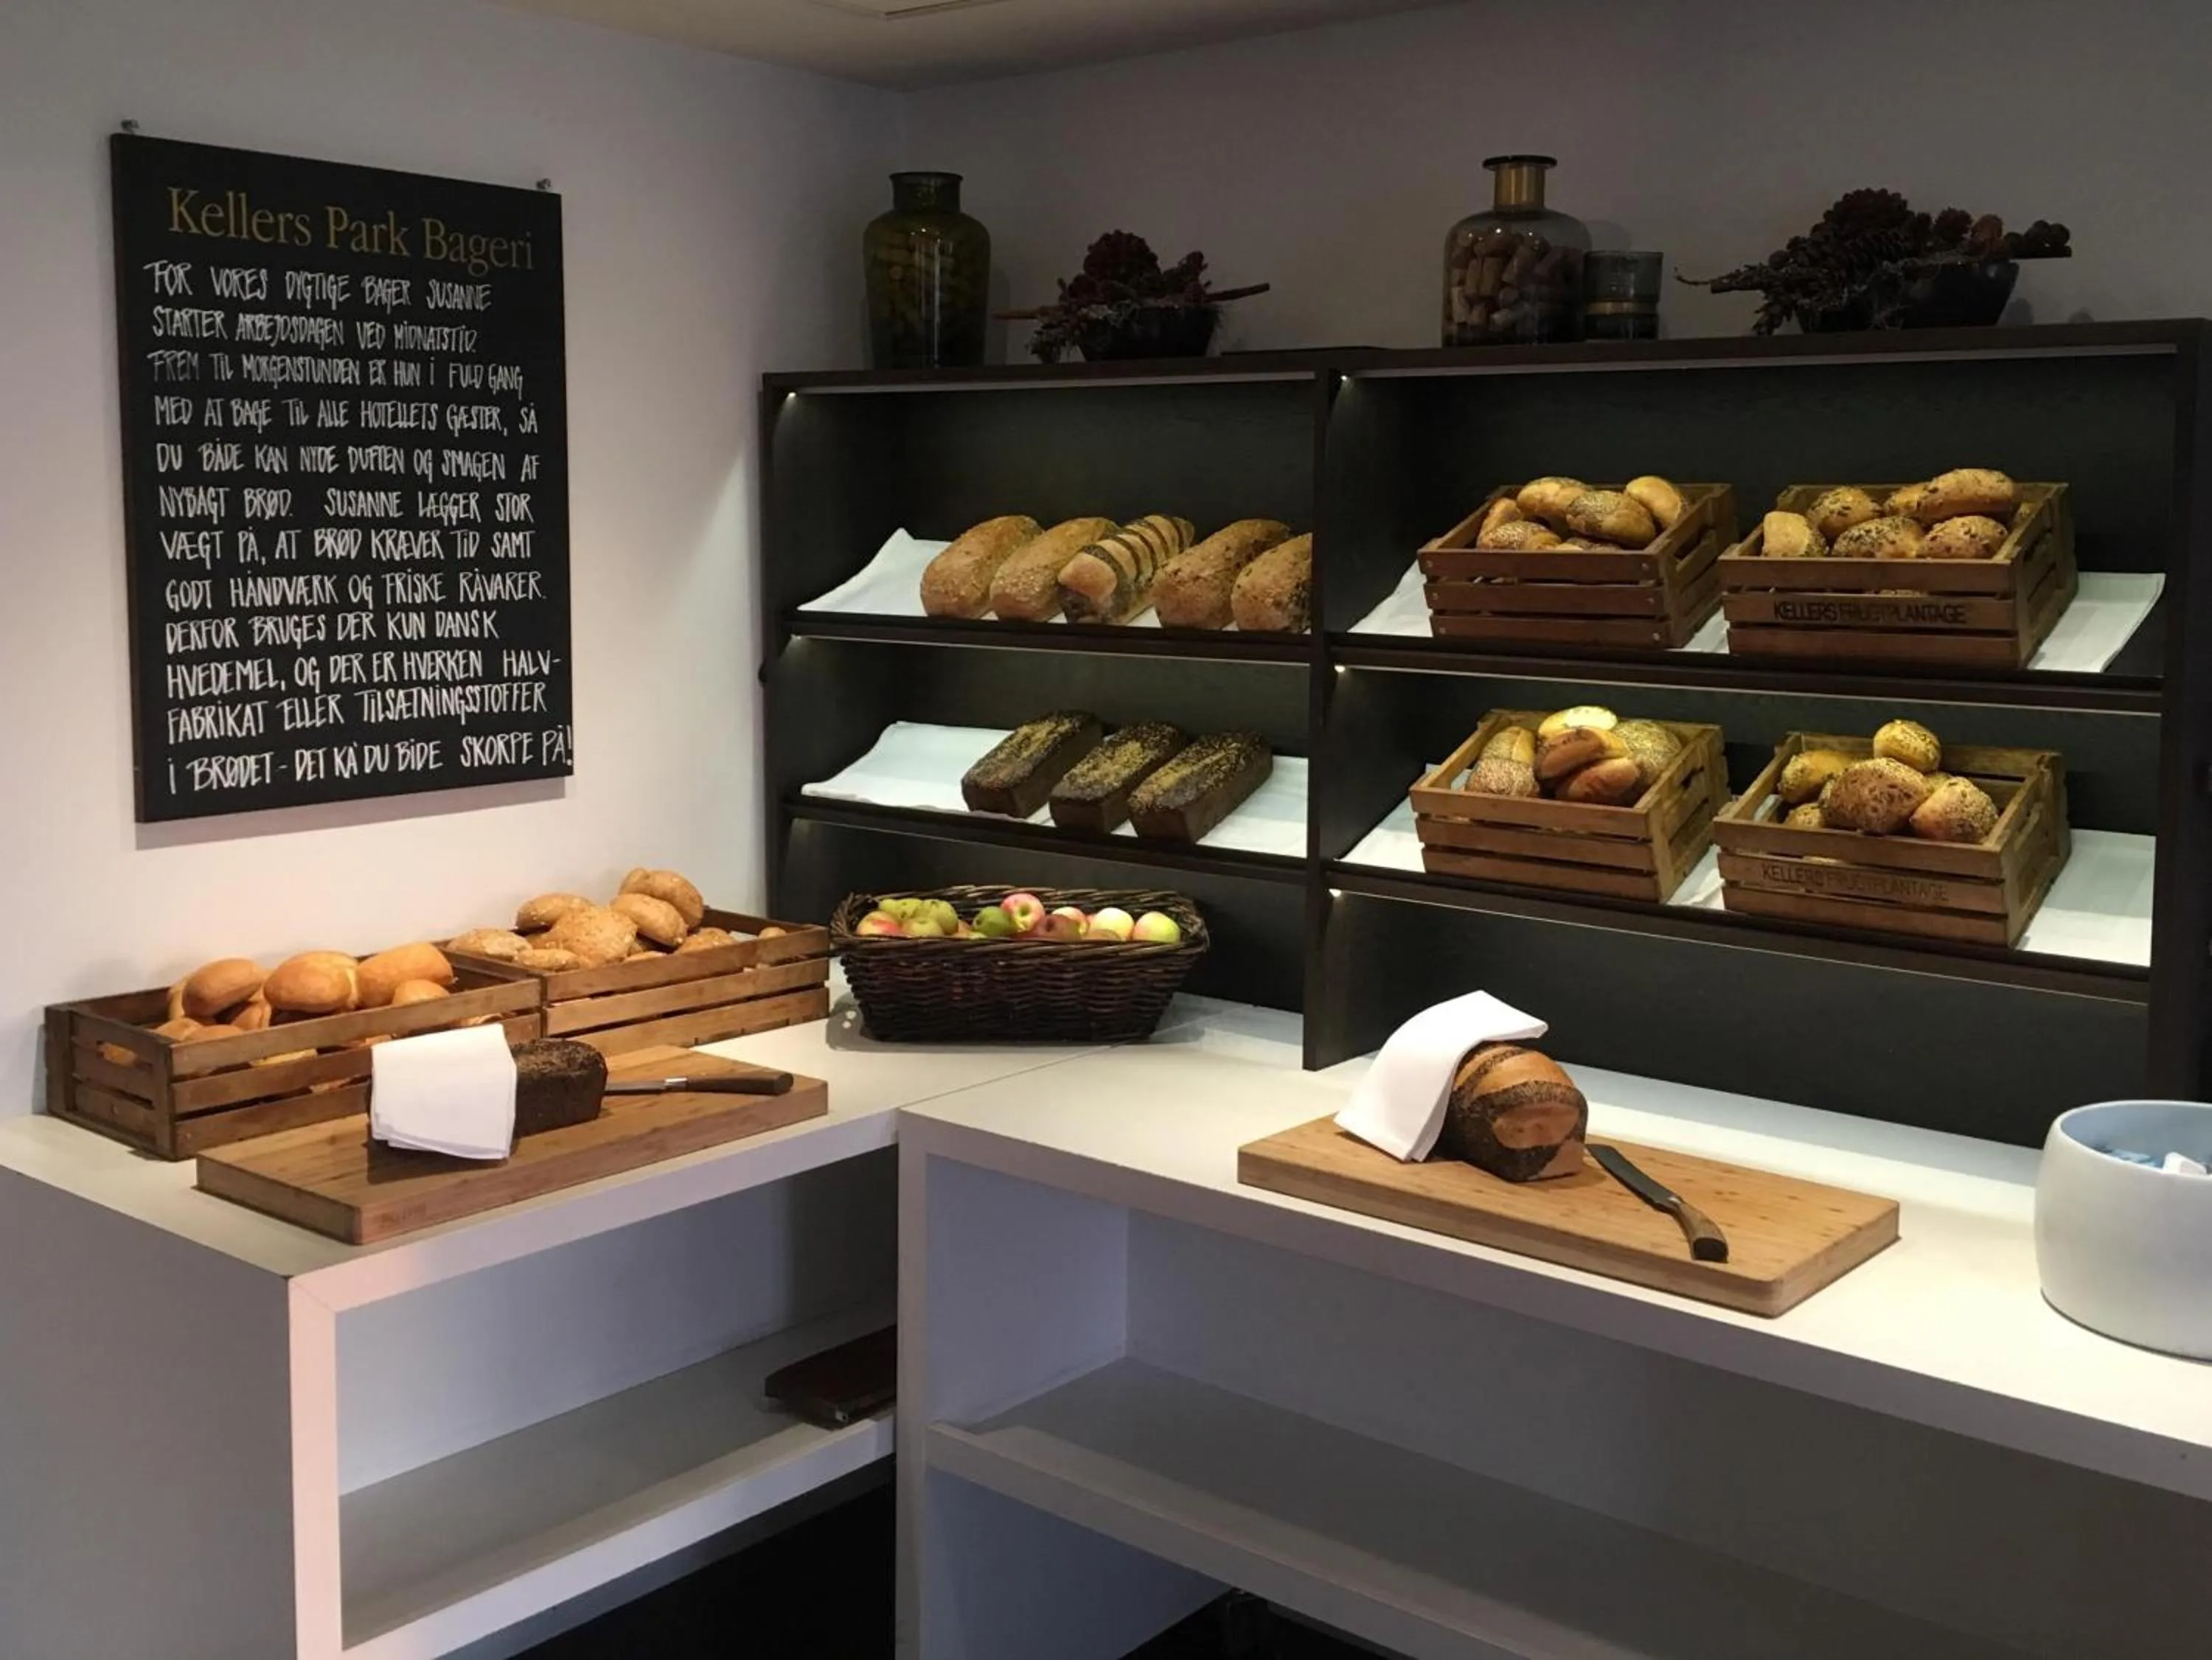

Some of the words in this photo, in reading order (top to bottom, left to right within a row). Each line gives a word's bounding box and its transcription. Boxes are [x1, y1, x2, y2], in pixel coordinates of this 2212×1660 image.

[167, 186, 311, 246] Kellers
[325, 206, 411, 257] Park
[422, 217, 535, 277] Bageri
[144, 259, 192, 297] FOR
[210, 265, 268, 301] VORES
[285, 271, 350, 310] DYGTIGE
[361, 275, 411, 314] BAGER
[425, 279, 492, 311] SUSANNE
[151, 307, 229, 340] STARTER
[236, 313, 344, 352] ARBEJDSDAGEN
[355, 321, 385, 349] VED
[146, 349, 200, 383] FREM
[242, 354, 360, 389] MORGENSTUNDEN
[369, 360, 386, 386] ER
[394, 362, 421, 388] HUN
[449, 363, 483, 390] FULD
[487, 364, 523, 400] GANG
[154, 395, 192, 426] MED
[204, 397, 226, 427] AT
[230, 398, 272, 435] BAGE
[317, 400, 349, 428] ALLE
[361, 401, 437, 430] HOTELLETS
[446, 404, 509, 436] GÆSTER,
[519, 403, 538, 435] SÅ
[156, 443, 182, 472] DU
[198, 438, 244, 472] BÅDE
[255, 444, 288, 475] KAN
[300, 445, 340, 475] NYDE
[348, 447, 405, 475] DUFTEN
[414, 449, 433, 484] OG
[442, 450, 507, 482] SMAGEN
[521, 455, 540, 483] AF
[159, 485, 230, 524] NYBAGT
[243, 487, 293, 521] BRØD.
[324, 489, 403, 517] SUSANNE
[418, 491, 481, 526] LÆGGER
[495, 492, 534, 523] STOR
[160, 530, 223, 569] VÆGT
[237, 526, 266, 566] PÅ,
[275, 530, 302, 562] AT
[314, 529, 362, 562] BRØD
[371, 529, 445, 560] KRÆVER
[491, 530, 535, 559] SAMT
[165, 579, 212, 613] GODT
[230, 569, 339, 608] HÅNDVÆRK
[349, 575, 373, 610] OG
[459, 568, 546, 602] RÅVARER.
[165, 617, 239, 654] DERFOR
[248, 613, 327, 649] BRUGES
[337, 611, 376, 642] DER
[387, 611, 425, 641] KUN
[435, 610, 500, 639] DANSK
[167, 658, 286, 700] HVEDEMEL,
[294, 656, 321, 694] OG
[329, 653, 366, 685] DER
[372, 652, 397, 683] ER
[403, 649, 483, 683] HVERKEN
[502, 648, 560, 678] HALV-
[276, 692, 345, 732] ELLER
[187, 752, 274, 792] BRØDET
[294, 750, 326, 783] DET
[364, 742, 391, 775] DU
[459, 728, 534, 767] SKORPE
[541, 725, 573, 766] PÅ!
